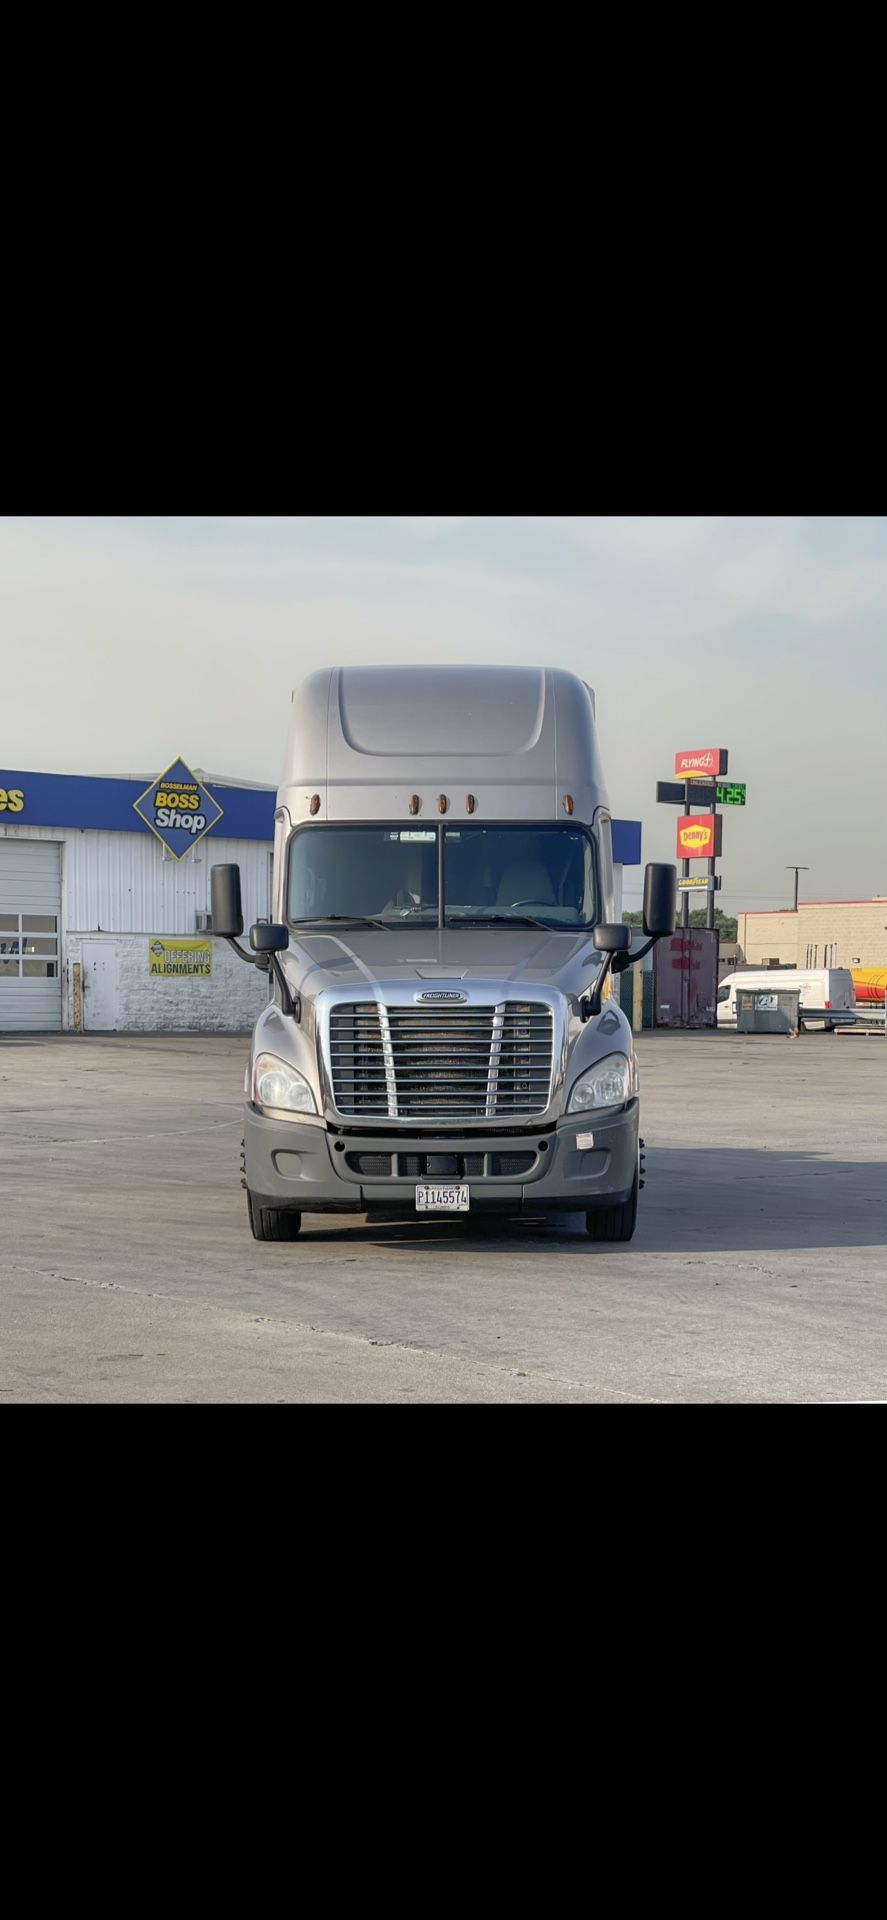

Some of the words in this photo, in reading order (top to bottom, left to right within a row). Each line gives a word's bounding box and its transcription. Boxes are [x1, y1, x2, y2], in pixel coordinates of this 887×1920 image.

[681, 757, 705, 768] FLYING
[160, 782, 198, 791] BOSSELMAN
[155, 792, 200, 810] BOSS
[155, 808, 206, 834] Shop
[683, 829, 708, 842] Denny's
[164, 950, 210, 963] OFFERING
[151, 963, 211, 974] ALIGNMENTS
[418, 1190, 467, 1204] P1145574
